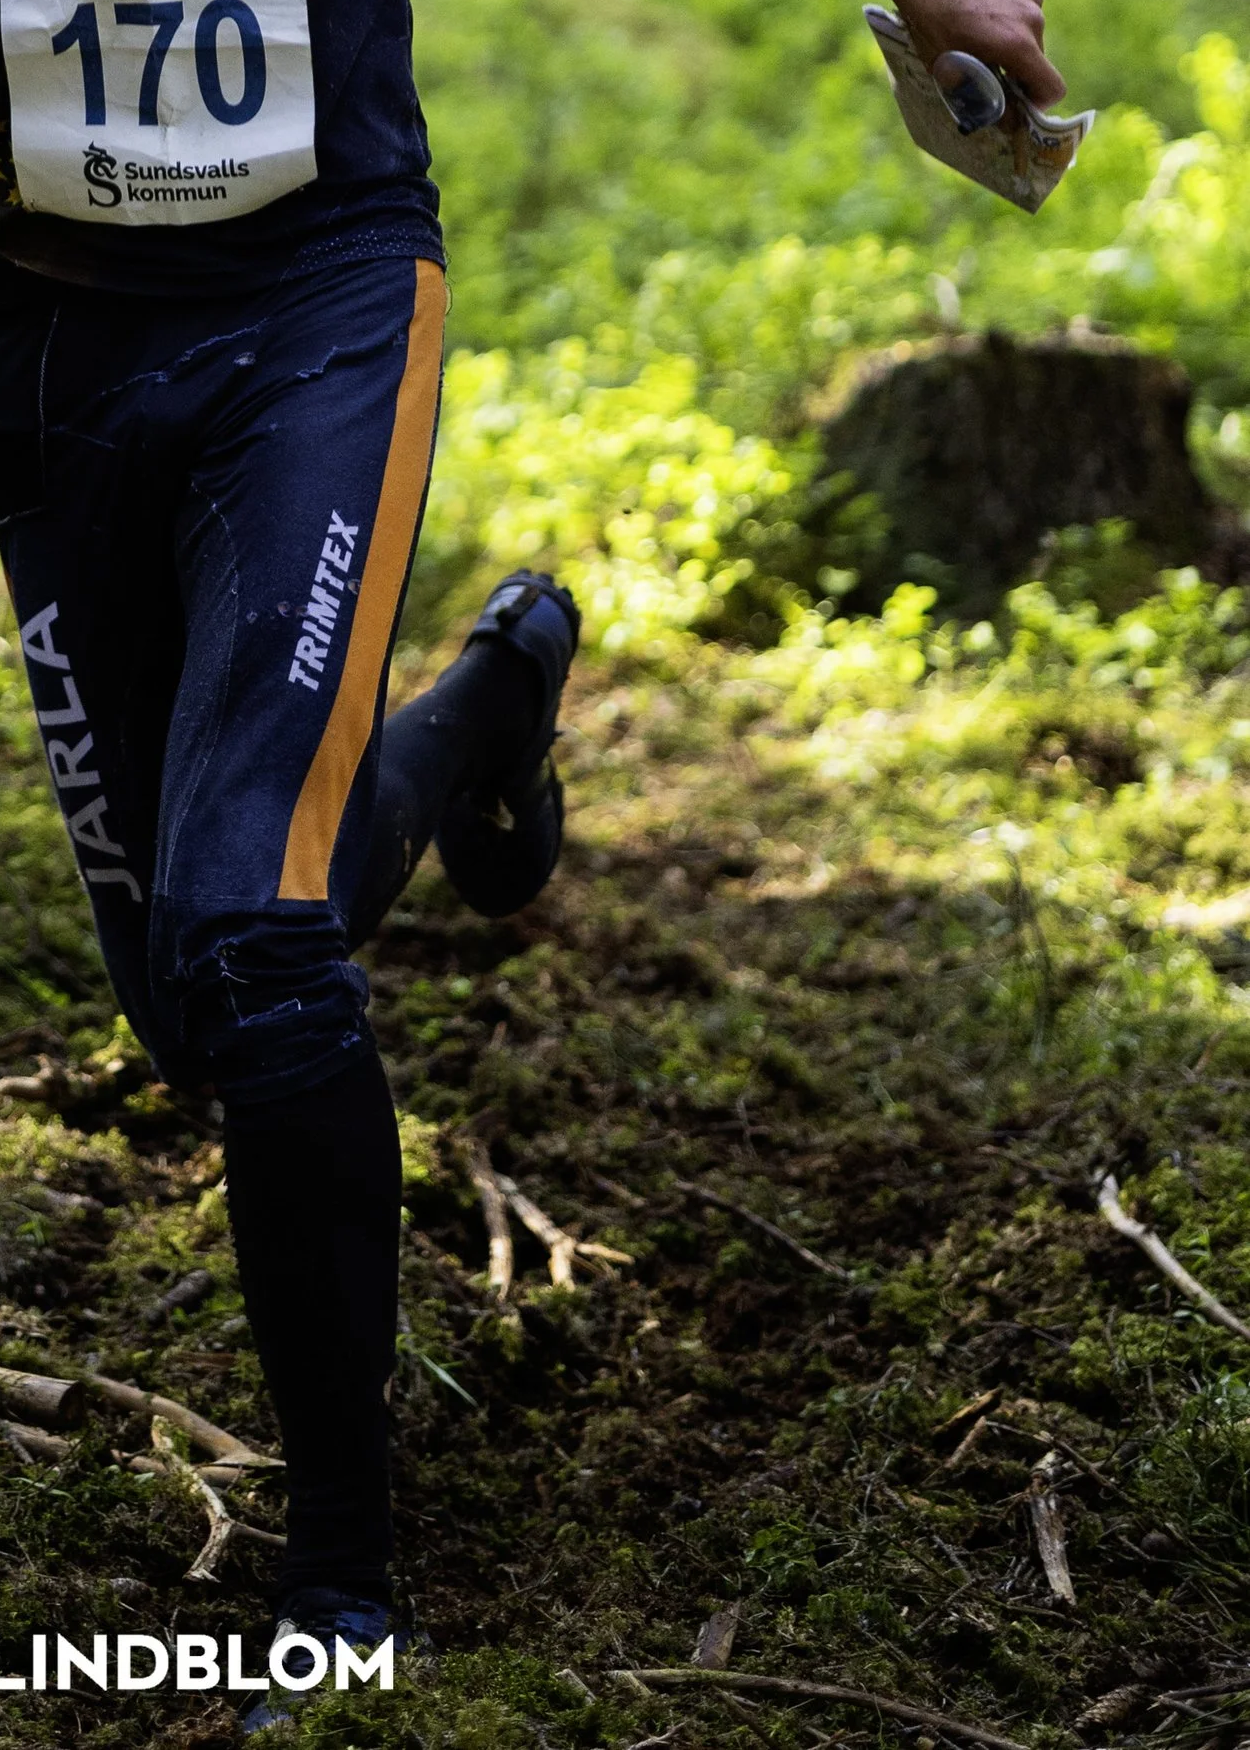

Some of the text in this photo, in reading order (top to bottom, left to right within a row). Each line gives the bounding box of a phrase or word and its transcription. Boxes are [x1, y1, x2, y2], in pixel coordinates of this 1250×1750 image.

[124, 157, 250, 182] Sundsvalls
[127, 182, 228, 203] kommun
[288, 510, 359, 691] TRIMTEX
